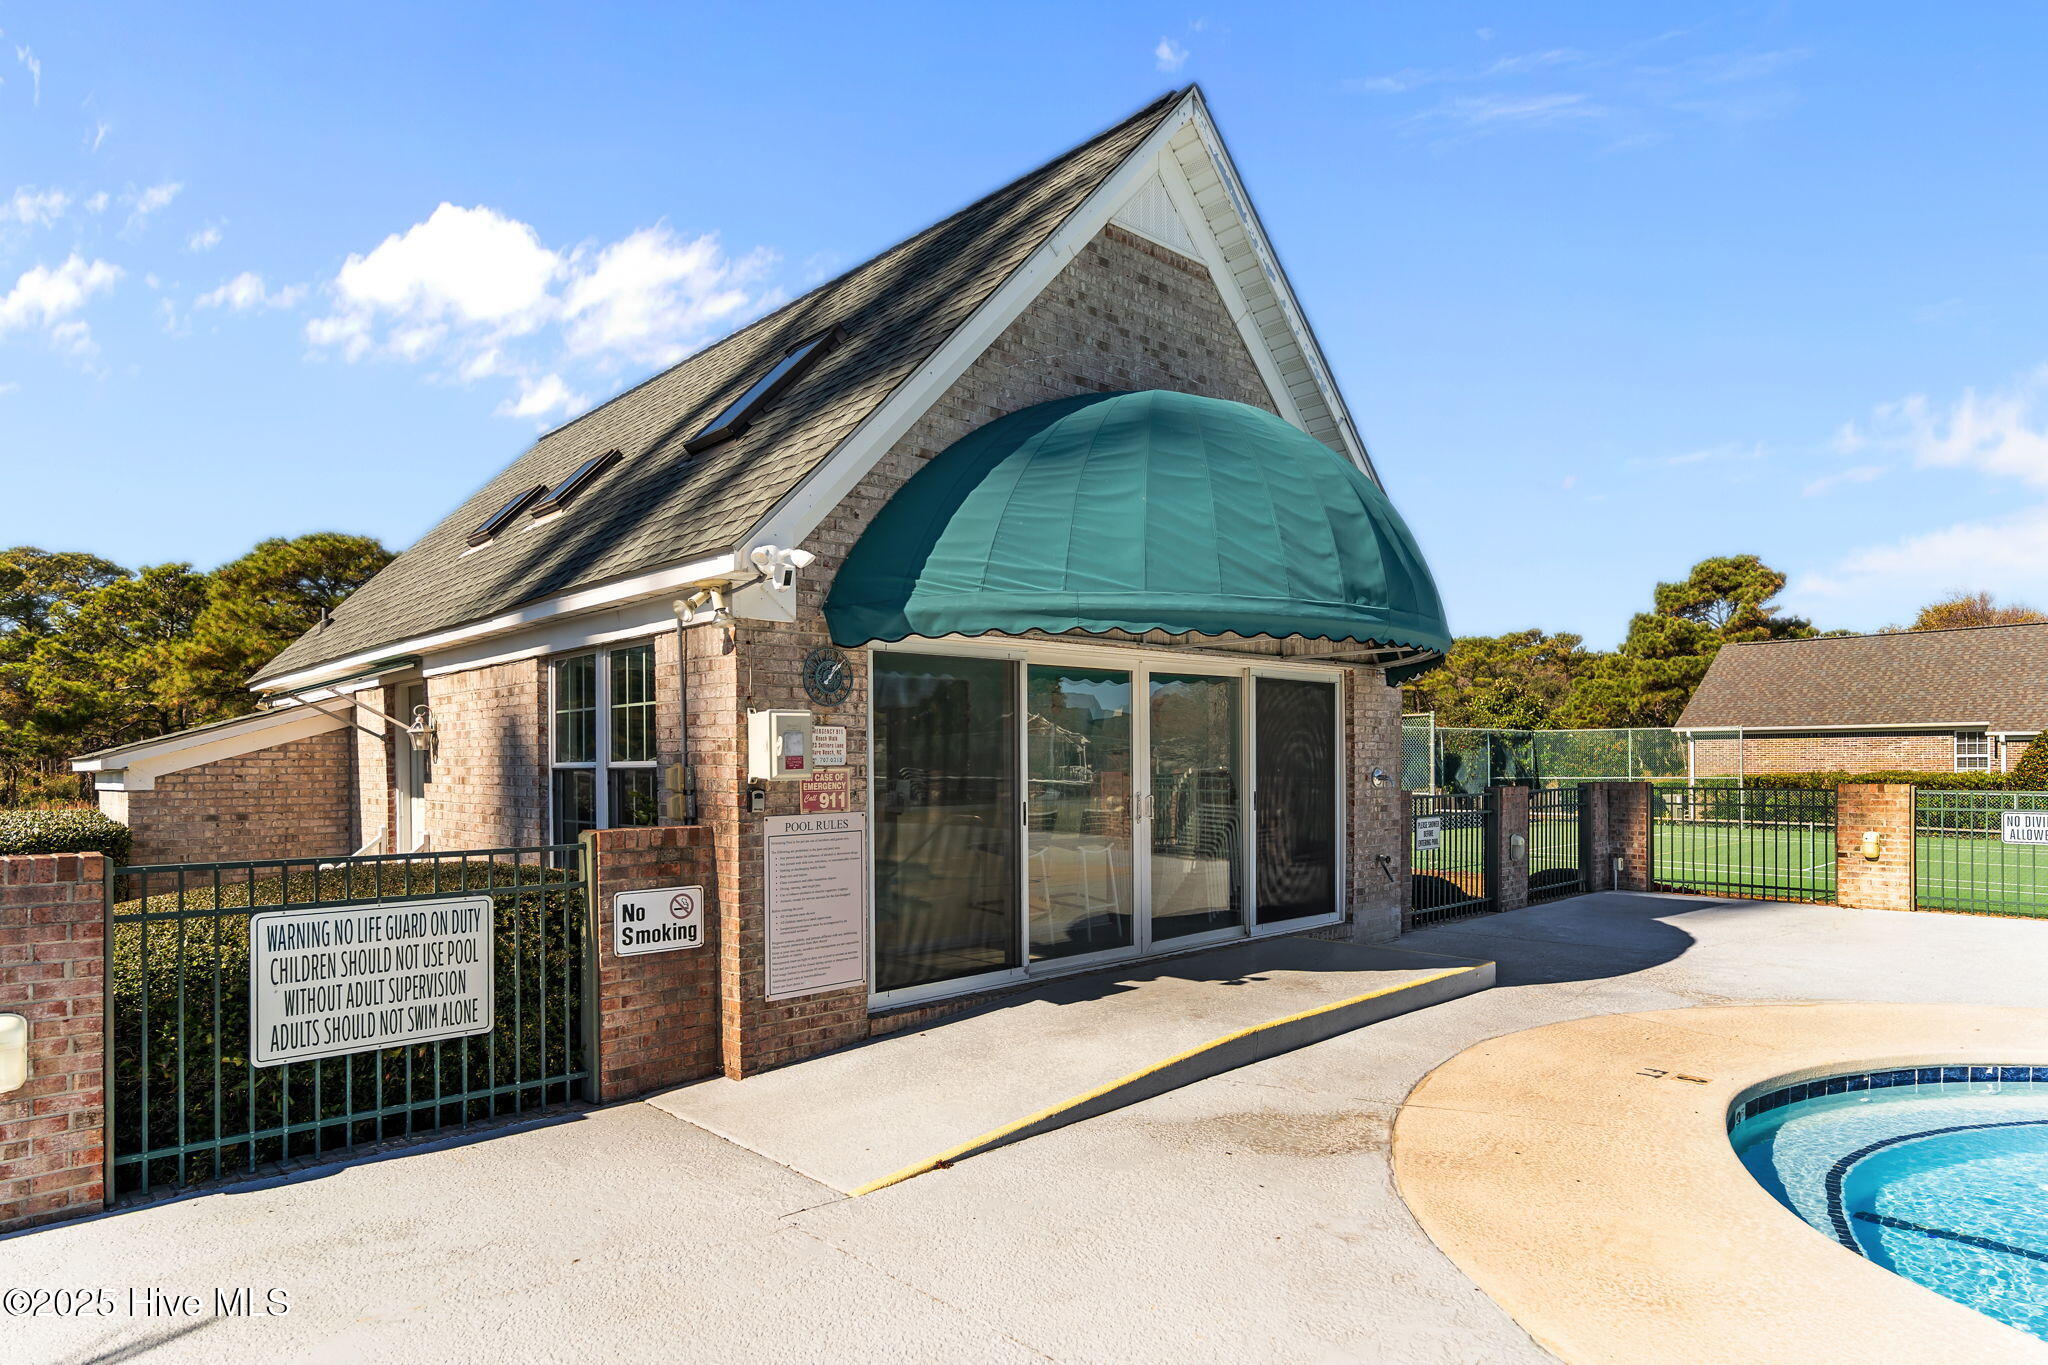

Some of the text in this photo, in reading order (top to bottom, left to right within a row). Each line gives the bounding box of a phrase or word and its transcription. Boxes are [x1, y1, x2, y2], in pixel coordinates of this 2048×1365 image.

[803, 782, 846, 790] EMERGENCY
[814, 773, 834, 782] CASE
[835, 773, 845, 781] OF
[804, 792, 846, 809] Call 911
[785, 819, 849, 832] POOL RULES
[2007, 816, 2048, 827] NO DIVI
[622, 904, 645, 922] No
[267, 908, 481, 952] WARNING NO LIFE GUARD ON DUTY
[622, 923, 697, 946] Smoking
[270, 938, 479, 985] CHILDREN SHOULD NOT USE POOL
[284, 970, 466, 1016] WITHOUT ADULT SUPERVISION
[271, 998, 478, 1052] ADULTS SHOULD NOT SWIM ALONE
